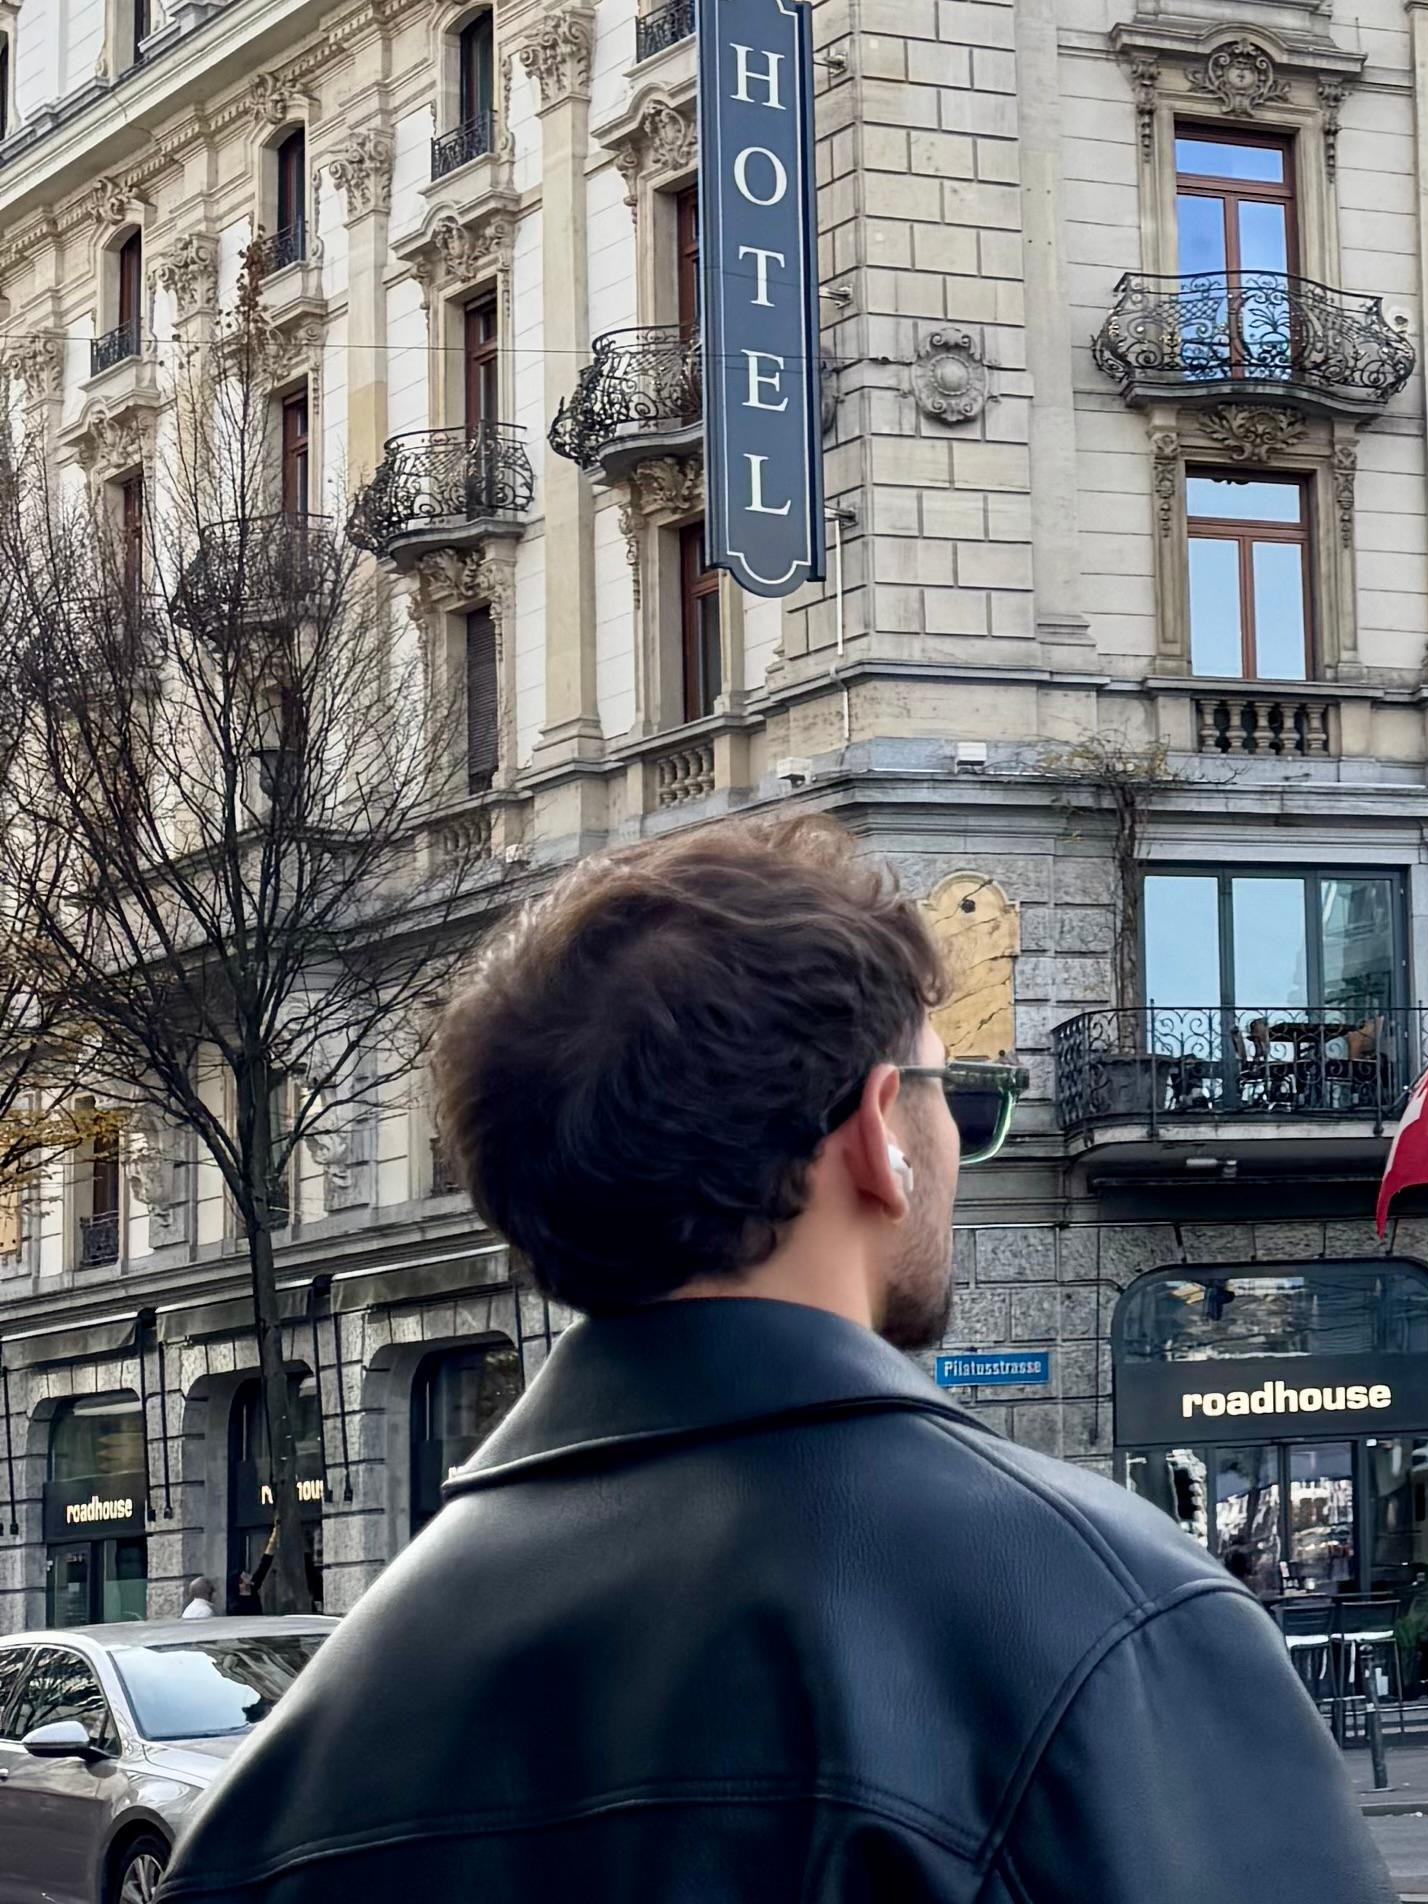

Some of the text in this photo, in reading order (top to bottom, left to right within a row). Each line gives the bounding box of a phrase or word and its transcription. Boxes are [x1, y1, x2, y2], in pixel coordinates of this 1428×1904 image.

[729, 42, 791, 516] HOTEL
[944, 1360, 1042, 1377] Pilatusstrasse
[1182, 1381, 1392, 1417] roadhouse
[66, 1496, 133, 1524] roadhouse
